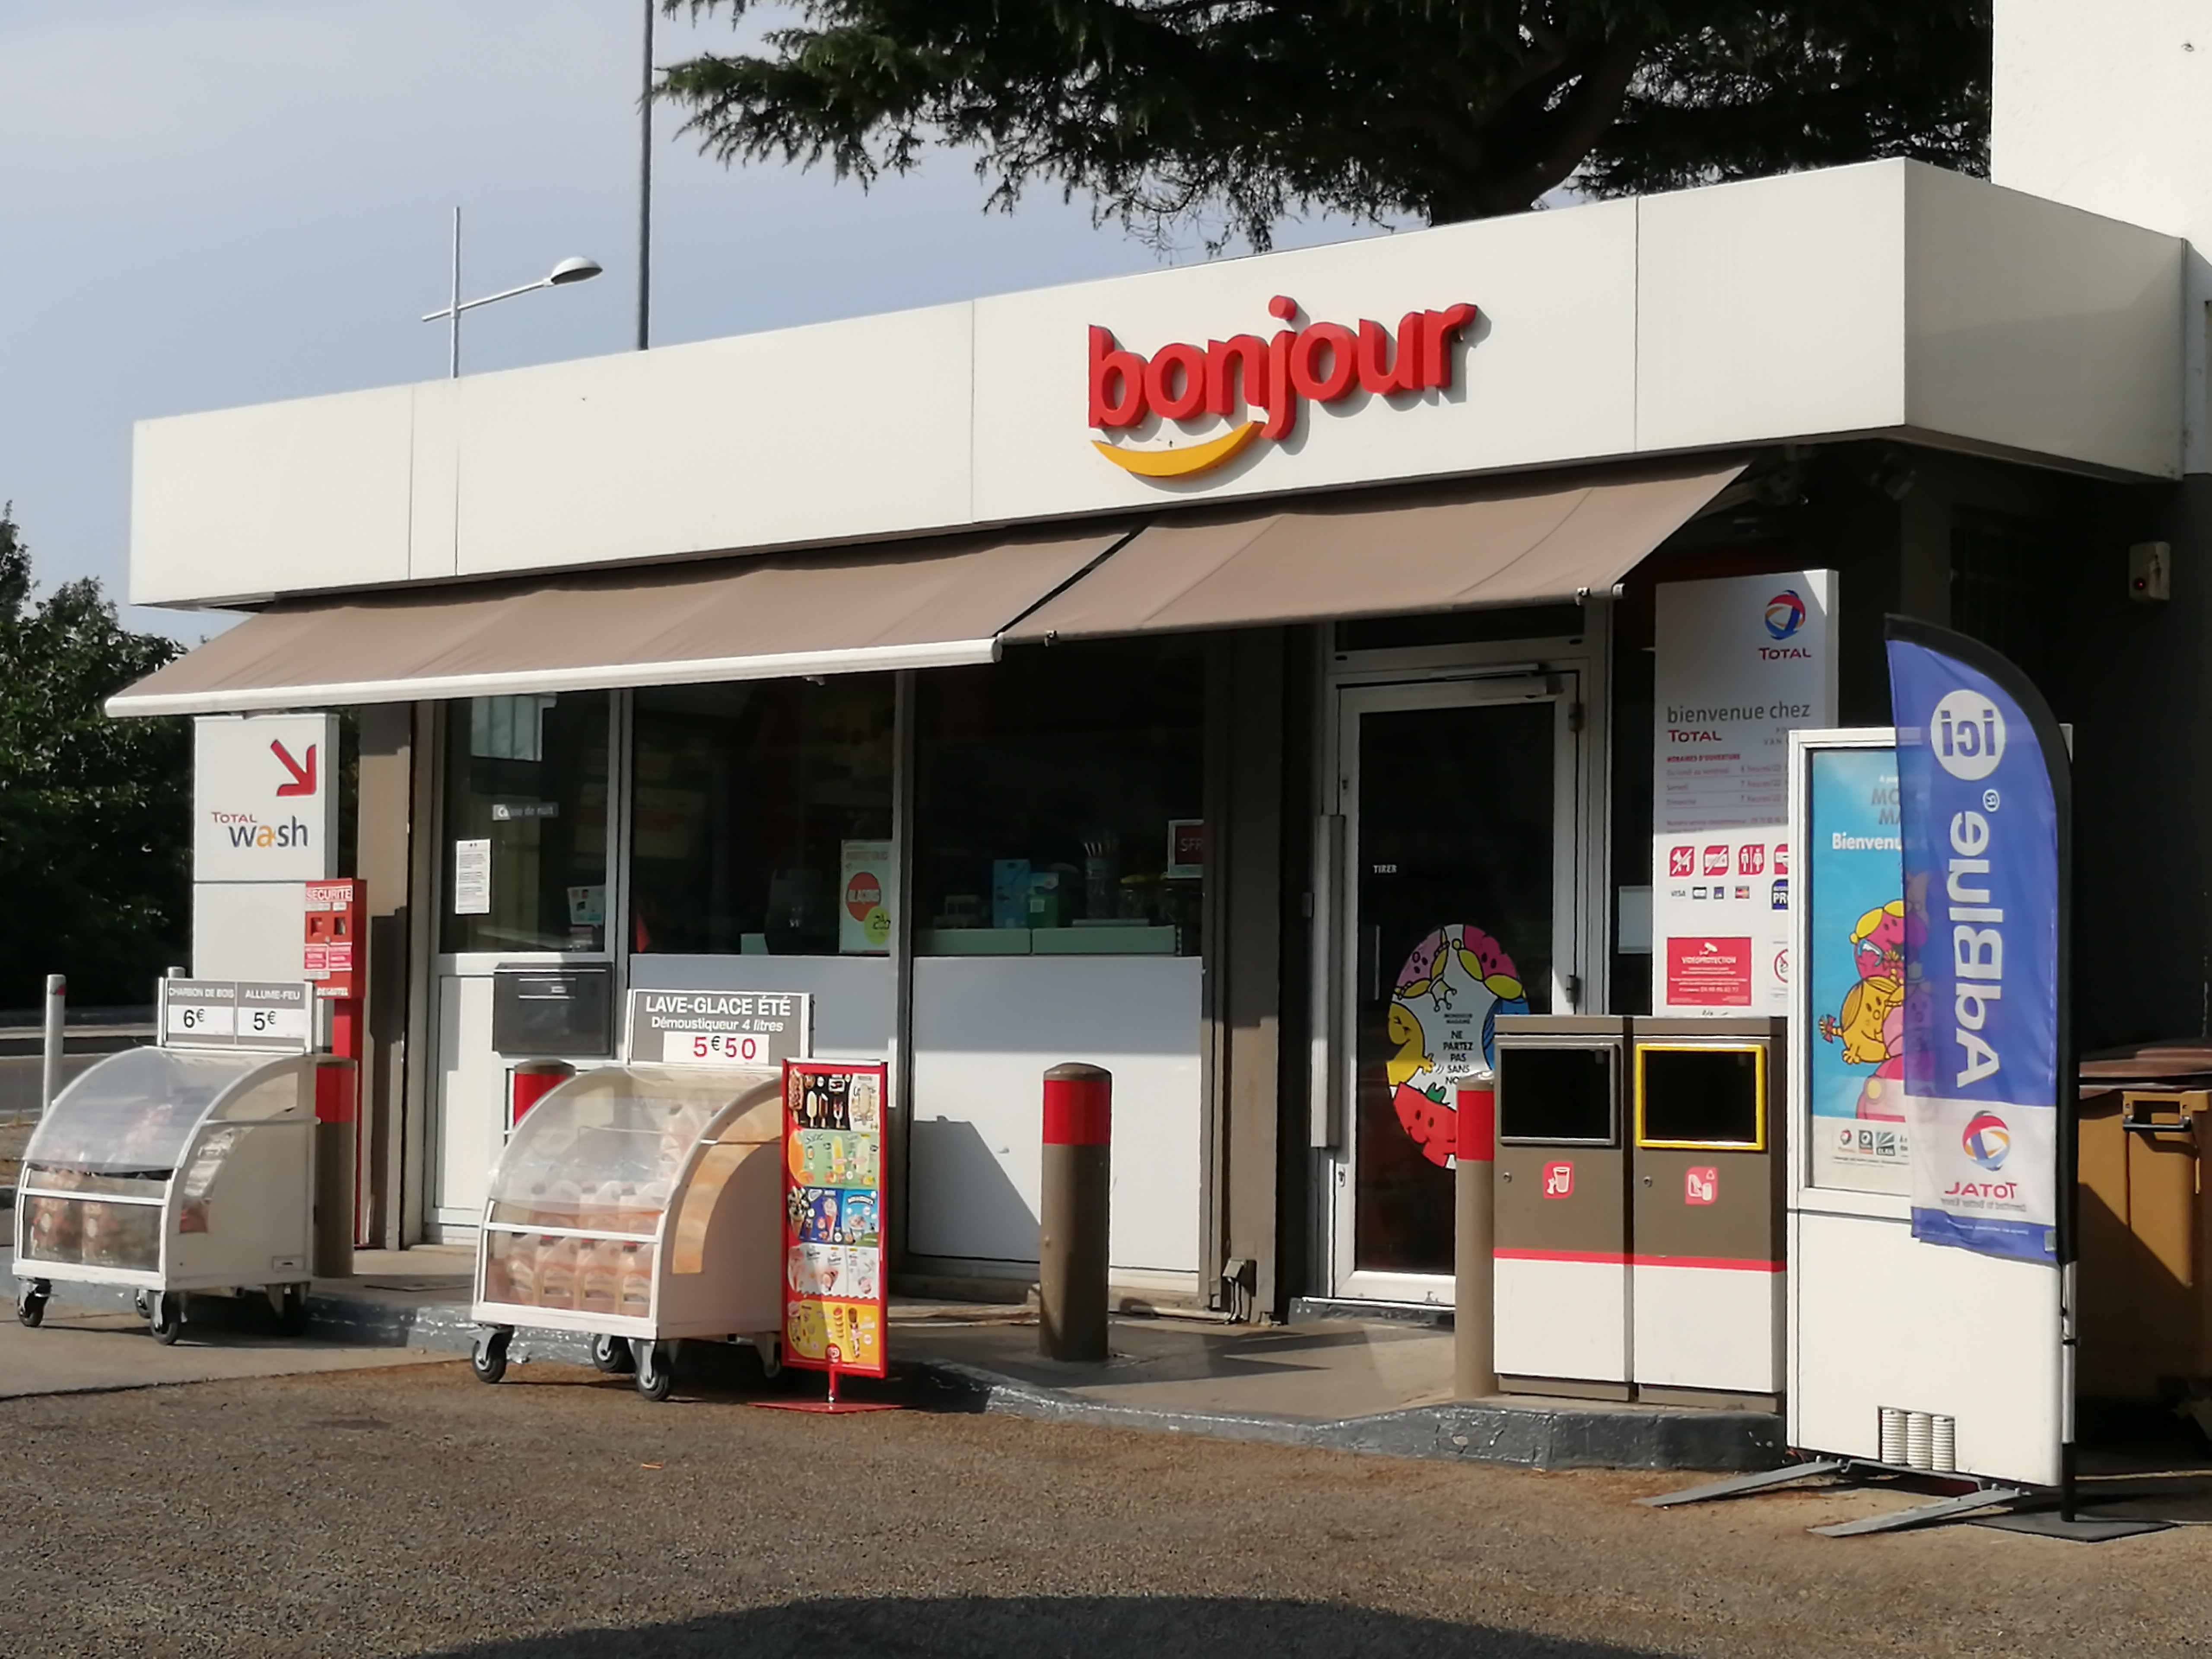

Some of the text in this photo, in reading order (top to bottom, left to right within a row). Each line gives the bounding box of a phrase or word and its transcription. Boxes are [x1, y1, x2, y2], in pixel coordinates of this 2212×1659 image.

[1088, 295, 1478, 440] bonjour
[1759, 647, 1812, 661] TOTAL
[1667, 701, 1811, 724] bienvenue chez
[1667, 729, 1722, 743] TOTAL
[1871, 788, 1899, 806] MO
[211, 811, 258, 823] TOTAL
[228, 815, 308, 848] wash
[1832, 833, 1902, 850] Bienvenu
[1373, 864, 1397, 874] TIRER
[168, 987, 234, 998] CHARBON DE BOIS
[245, 989, 301, 1001] ALLUME-FEU
[645, 995, 791, 1016] LAVE-GLACE ÉTÉ
[651, 1016, 784, 1032] Démoustiqueur 4 litres
[1451, 1030, 1463, 1039] NE
[1443, 1042, 1473, 1051] PARTEZ
[1450, 1053, 1467, 1062] PAS
[1447, 1065, 1470, 1073] SANS
[1445, 1076, 1460, 1085] NO
